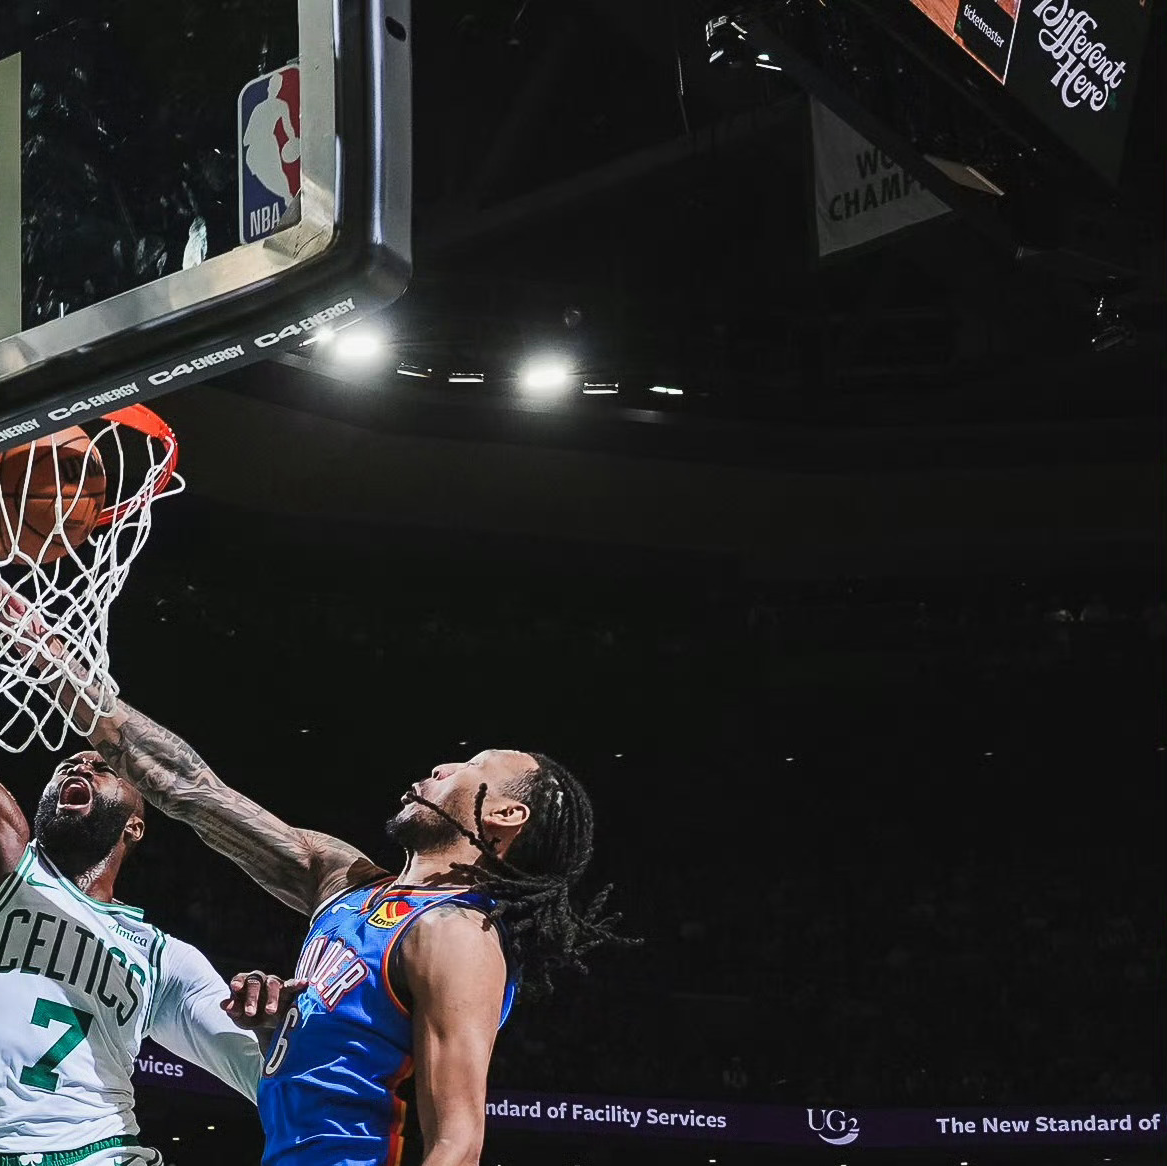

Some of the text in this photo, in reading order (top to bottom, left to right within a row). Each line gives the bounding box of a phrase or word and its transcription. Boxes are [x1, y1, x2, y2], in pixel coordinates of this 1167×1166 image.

[963, 4, 1005, 48] ticketmaster
[1033, 0, 1126, 88] Different
[1044, 45, 1110, 111] Here
[250, 202, 281, 237] NBA
[299, 297, 355, 331] ENERGY
[190, 344, 245, 369] ENERGY
[88, 382, 139, 407] ENERGY
[107, 922, 148, 948] Amica
[19, 997, 94, 1093] 7
[264, 1004, 300, 1078] 6
[547, 1103, 567, 1120] of
[572, 1104, 641, 1127] Facility
[647, 1108, 727, 1128] Services
[806, 1108, 860, 1132] UG2
[936, 1113, 1161, 1134] The New Standard of
